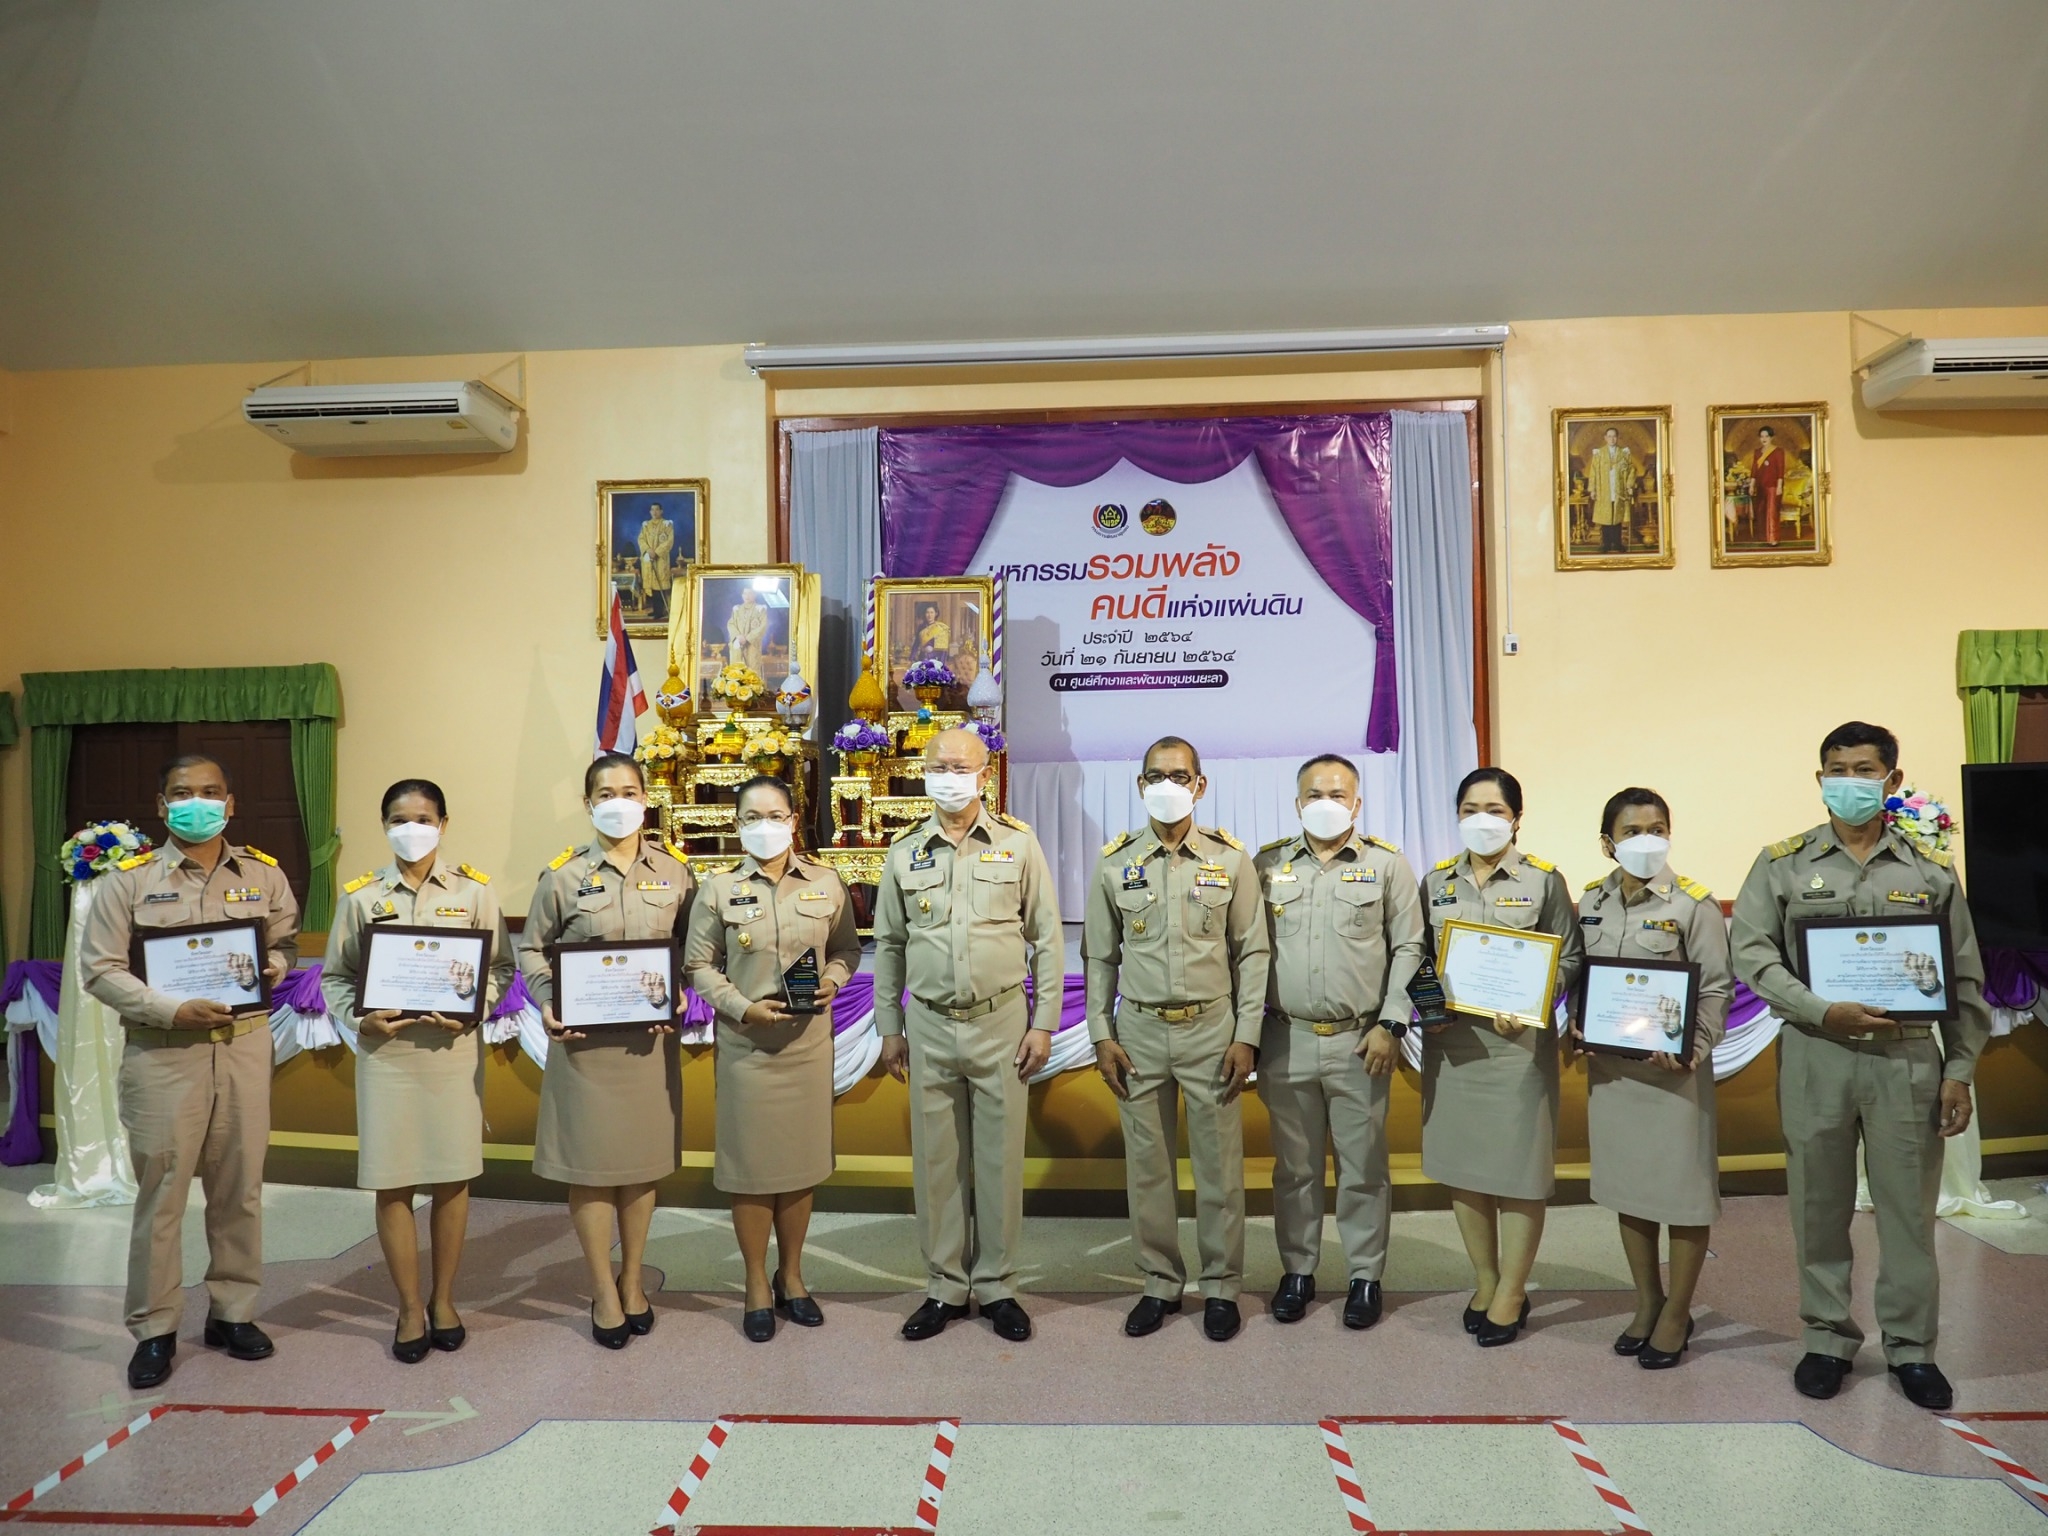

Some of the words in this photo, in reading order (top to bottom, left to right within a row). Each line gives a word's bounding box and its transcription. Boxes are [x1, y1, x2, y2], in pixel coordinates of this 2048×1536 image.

[1090, 585, 1303, 620] คนดีแห่งแผ่นดิน
[1083, 629, 1133, 645] ประจำปี
[1144, 631, 1193, 643] ๒๕๖๔
[1041, 647, 1075, 667] วันที่
[1080, 653, 1107, 666] ๒๑
[1113, 649, 1176, 665] กันยายน
[1183, 650, 1236, 663] ๒๕๖๔
[1054, 678, 1067, 687] ณ
[1070, 673, 1223, 689] ศูนย์ศึกษาและพัฒนาชุมชนยะลา
